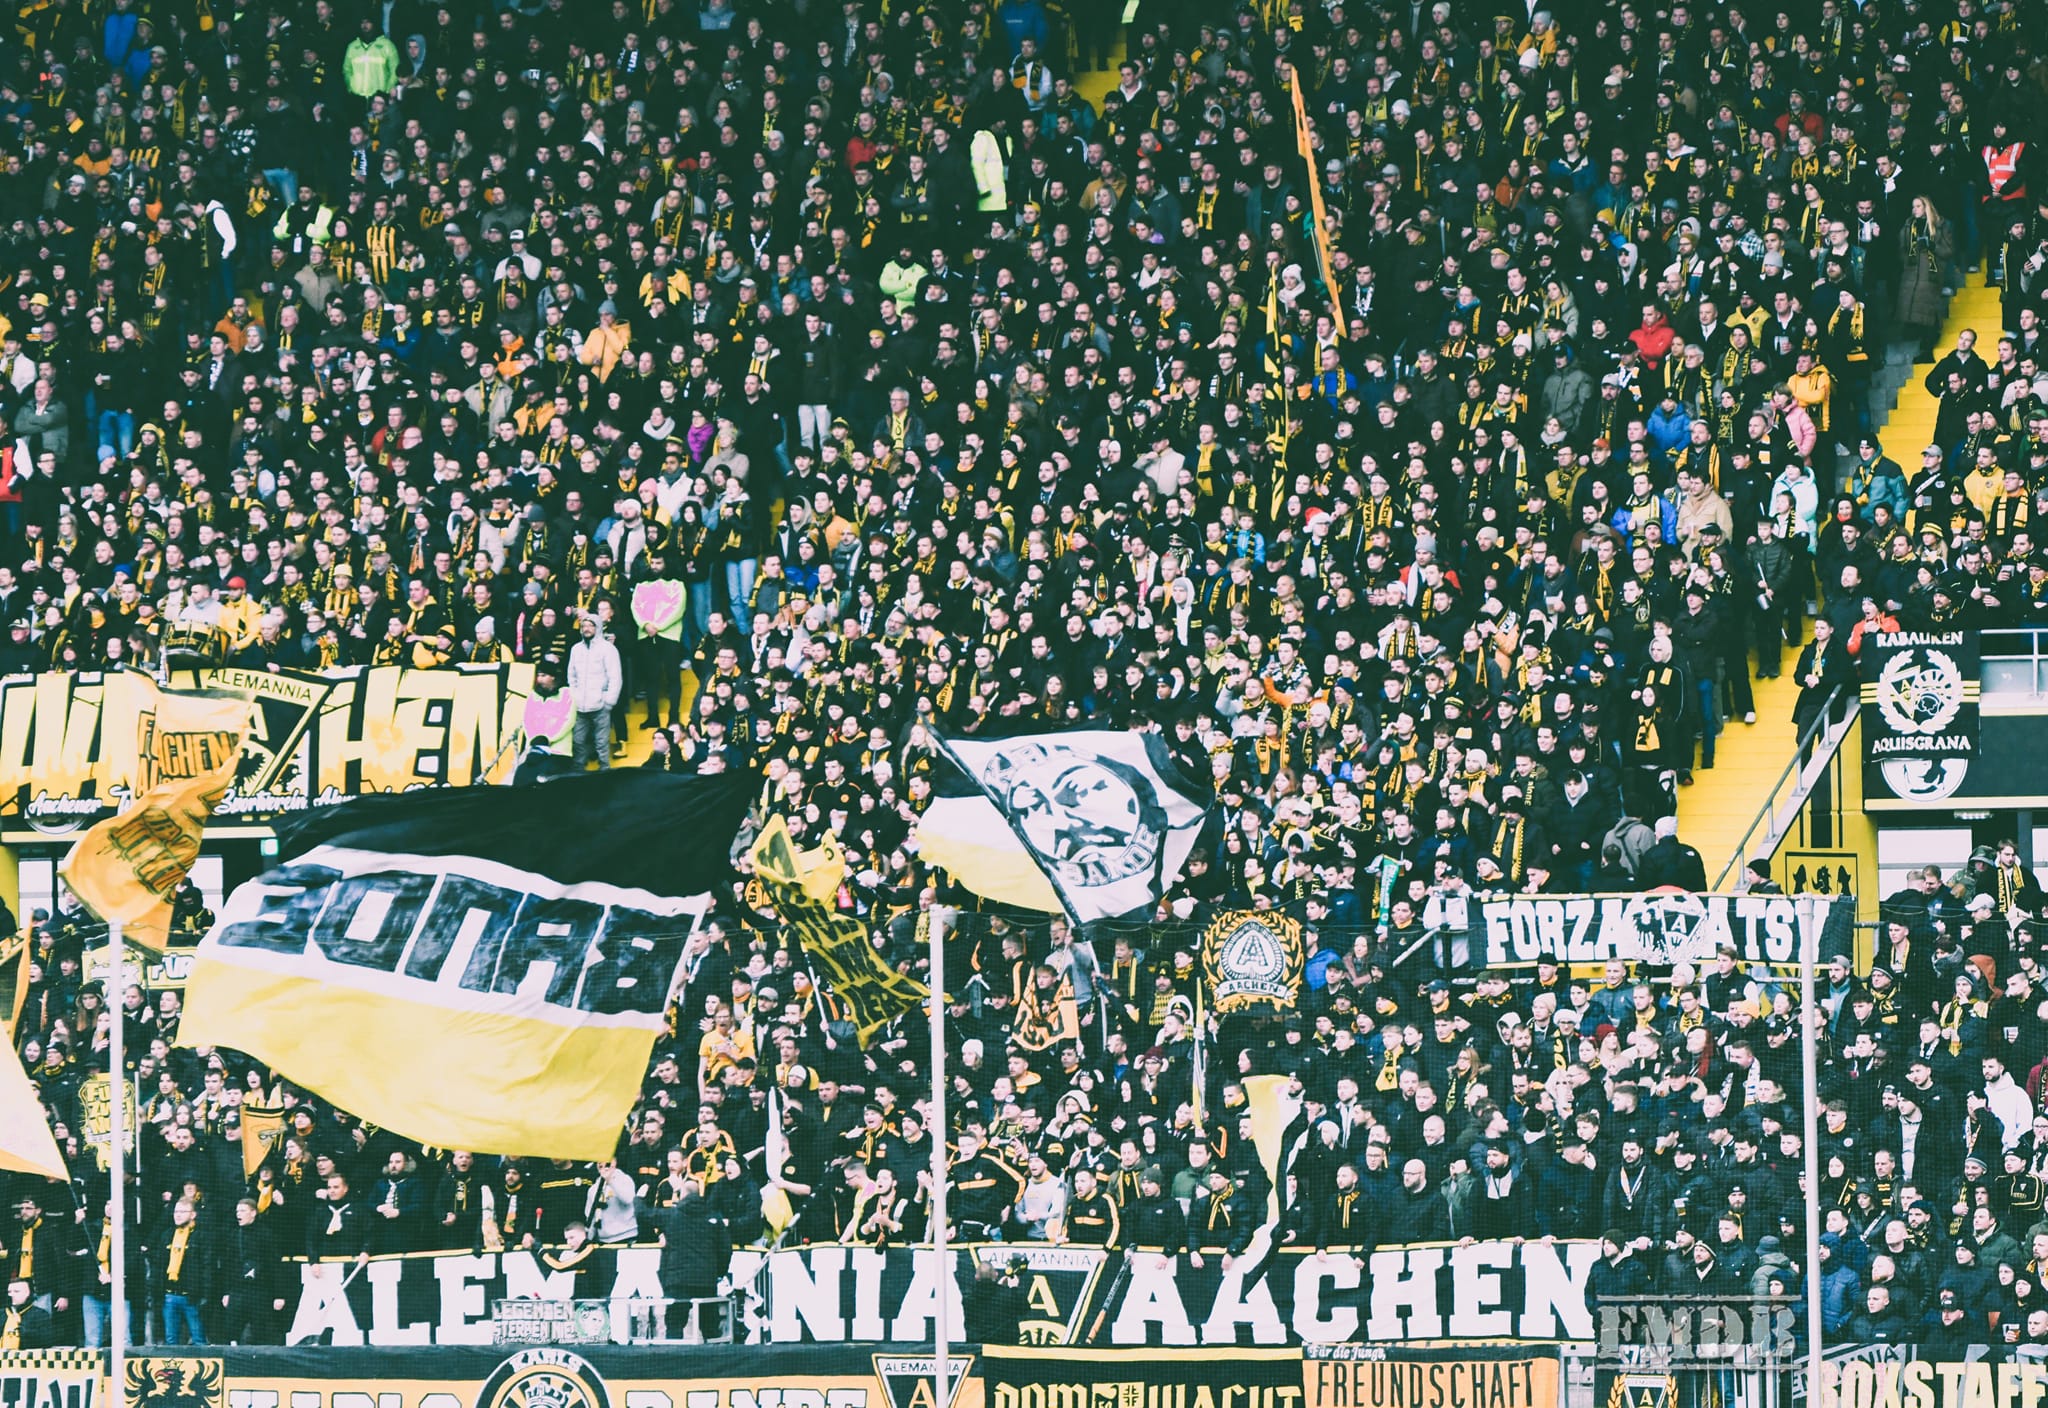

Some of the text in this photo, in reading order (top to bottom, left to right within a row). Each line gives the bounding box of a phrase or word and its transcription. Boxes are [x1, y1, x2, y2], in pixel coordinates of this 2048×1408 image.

[1876, 630, 1963, 648] RABAUKEN
[207, 669, 311, 701] ALEMANNIA
[1871, 735, 1972, 754] AQUISGRANA
[1483, 896, 1630, 962] FORZA
[1228, 981, 1280, 993] AACHEN
[1112, 1240, 1595, 1346] AACHEN
[1316, 1361, 1534, 1408] FREUNDSCHAFT
